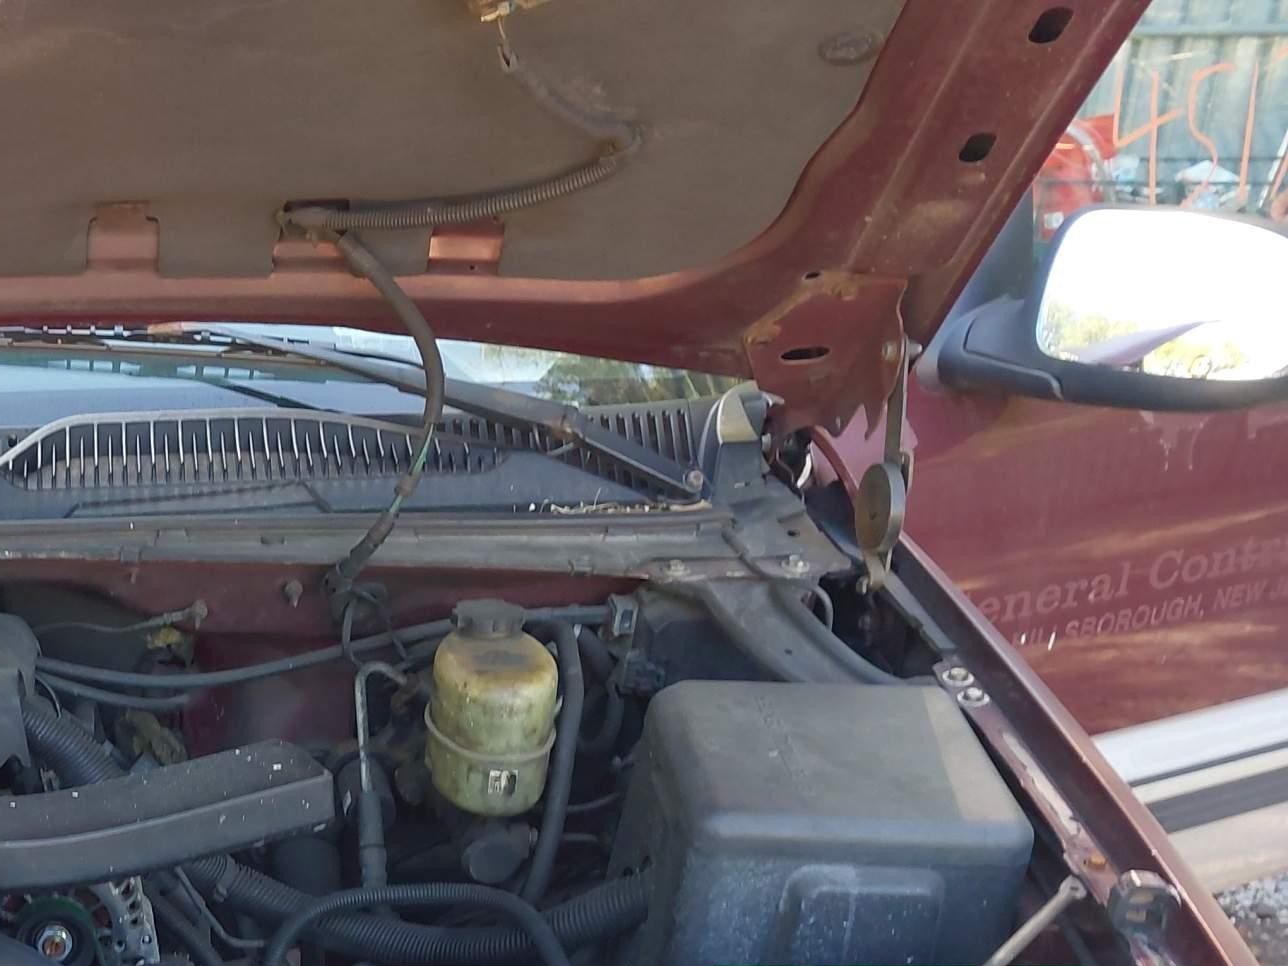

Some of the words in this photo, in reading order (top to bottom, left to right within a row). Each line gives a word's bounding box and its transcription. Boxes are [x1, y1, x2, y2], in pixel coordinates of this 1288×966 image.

[968, 559, 1134, 624] eneral
[1150, 534, 1288, 590] Contr
[1214, 579, 1268, 610] NEW
